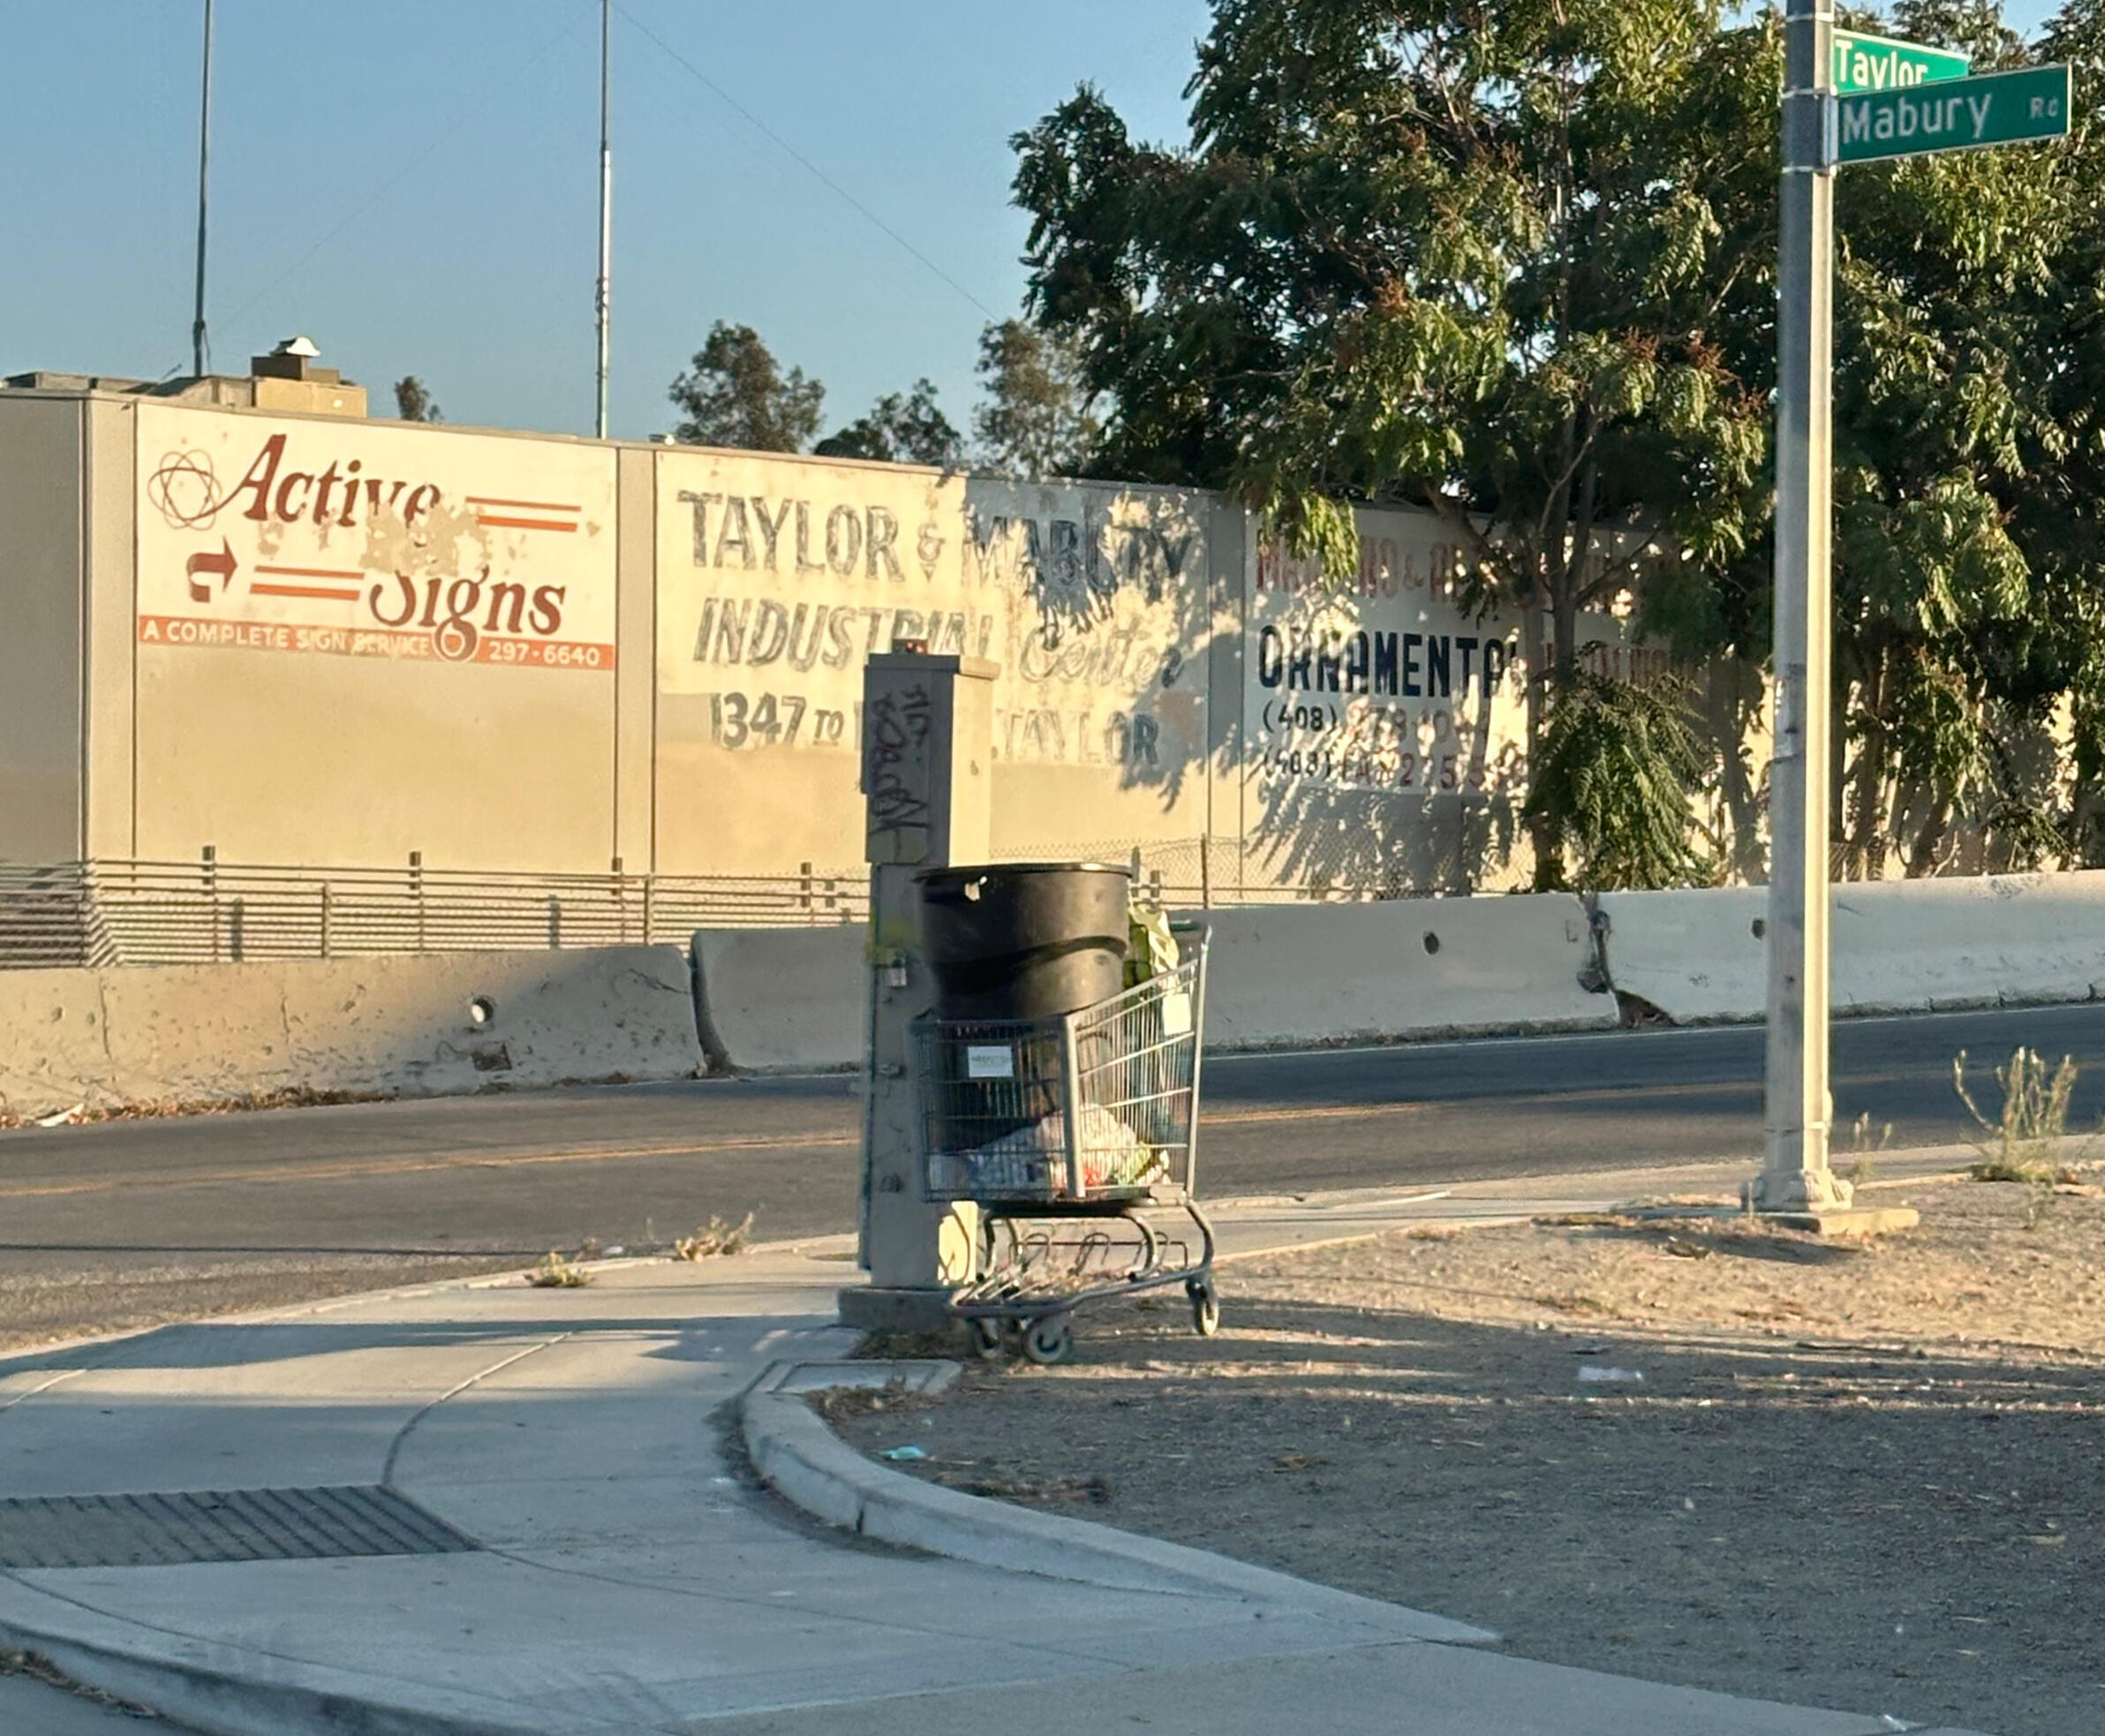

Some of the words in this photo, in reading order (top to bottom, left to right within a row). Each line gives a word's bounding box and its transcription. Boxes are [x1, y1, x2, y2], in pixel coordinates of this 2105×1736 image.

[1835, 40, 1928, 89] Taylor
[1843, 93, 1992, 144] Mabury
[2031, 96, 2059, 118] Rd
[216, 433, 441, 529] Active
[677, 490, 905, 582] TAYLOR
[369, 563, 567, 662] Signs
[143, 620, 160, 640] A
[166, 621, 290, 648] COMPLETE
[295, 628, 346, 651] SIGN
[488, 640, 600, 666] 297-6640
[710, 691, 807, 751] 1347
[814, 709, 845, 745] TO
[1263, 699, 1336, 734] (408)
